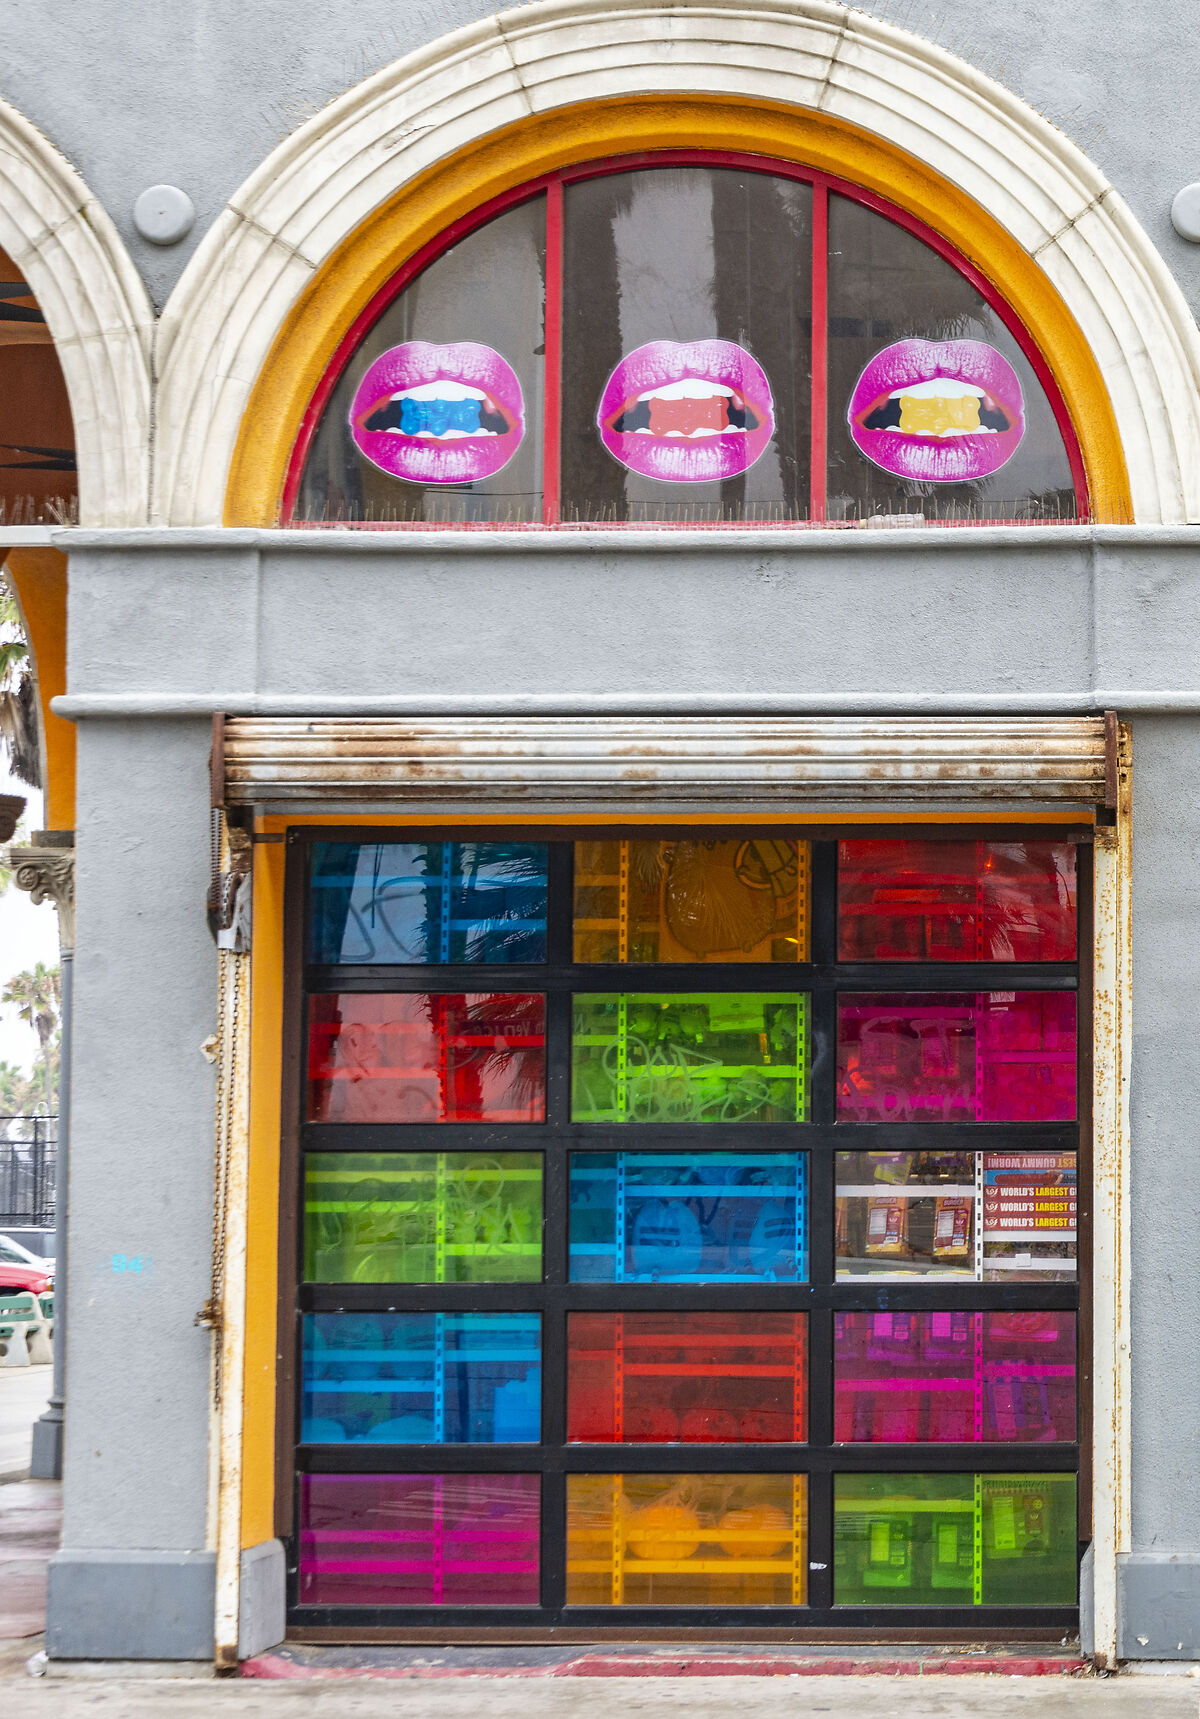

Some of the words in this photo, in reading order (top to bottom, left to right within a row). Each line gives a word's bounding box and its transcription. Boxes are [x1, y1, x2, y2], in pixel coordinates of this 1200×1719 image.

[987, 1157, 1021, 1168] WORM!
[1021, 1157, 1056, 1168] GUMMY
[1000, 1187, 1034, 1197] WORLD'S
[1035, 1187, 1068, 1197] LARGEST
[1000, 1202, 1034, 1212] WORLD'S
[1035, 1202, 1068, 1212] LARGEST
[999, 1217, 1034, 1227] WORLD'S
[1035, 1217, 1068, 1227] LARGEST
